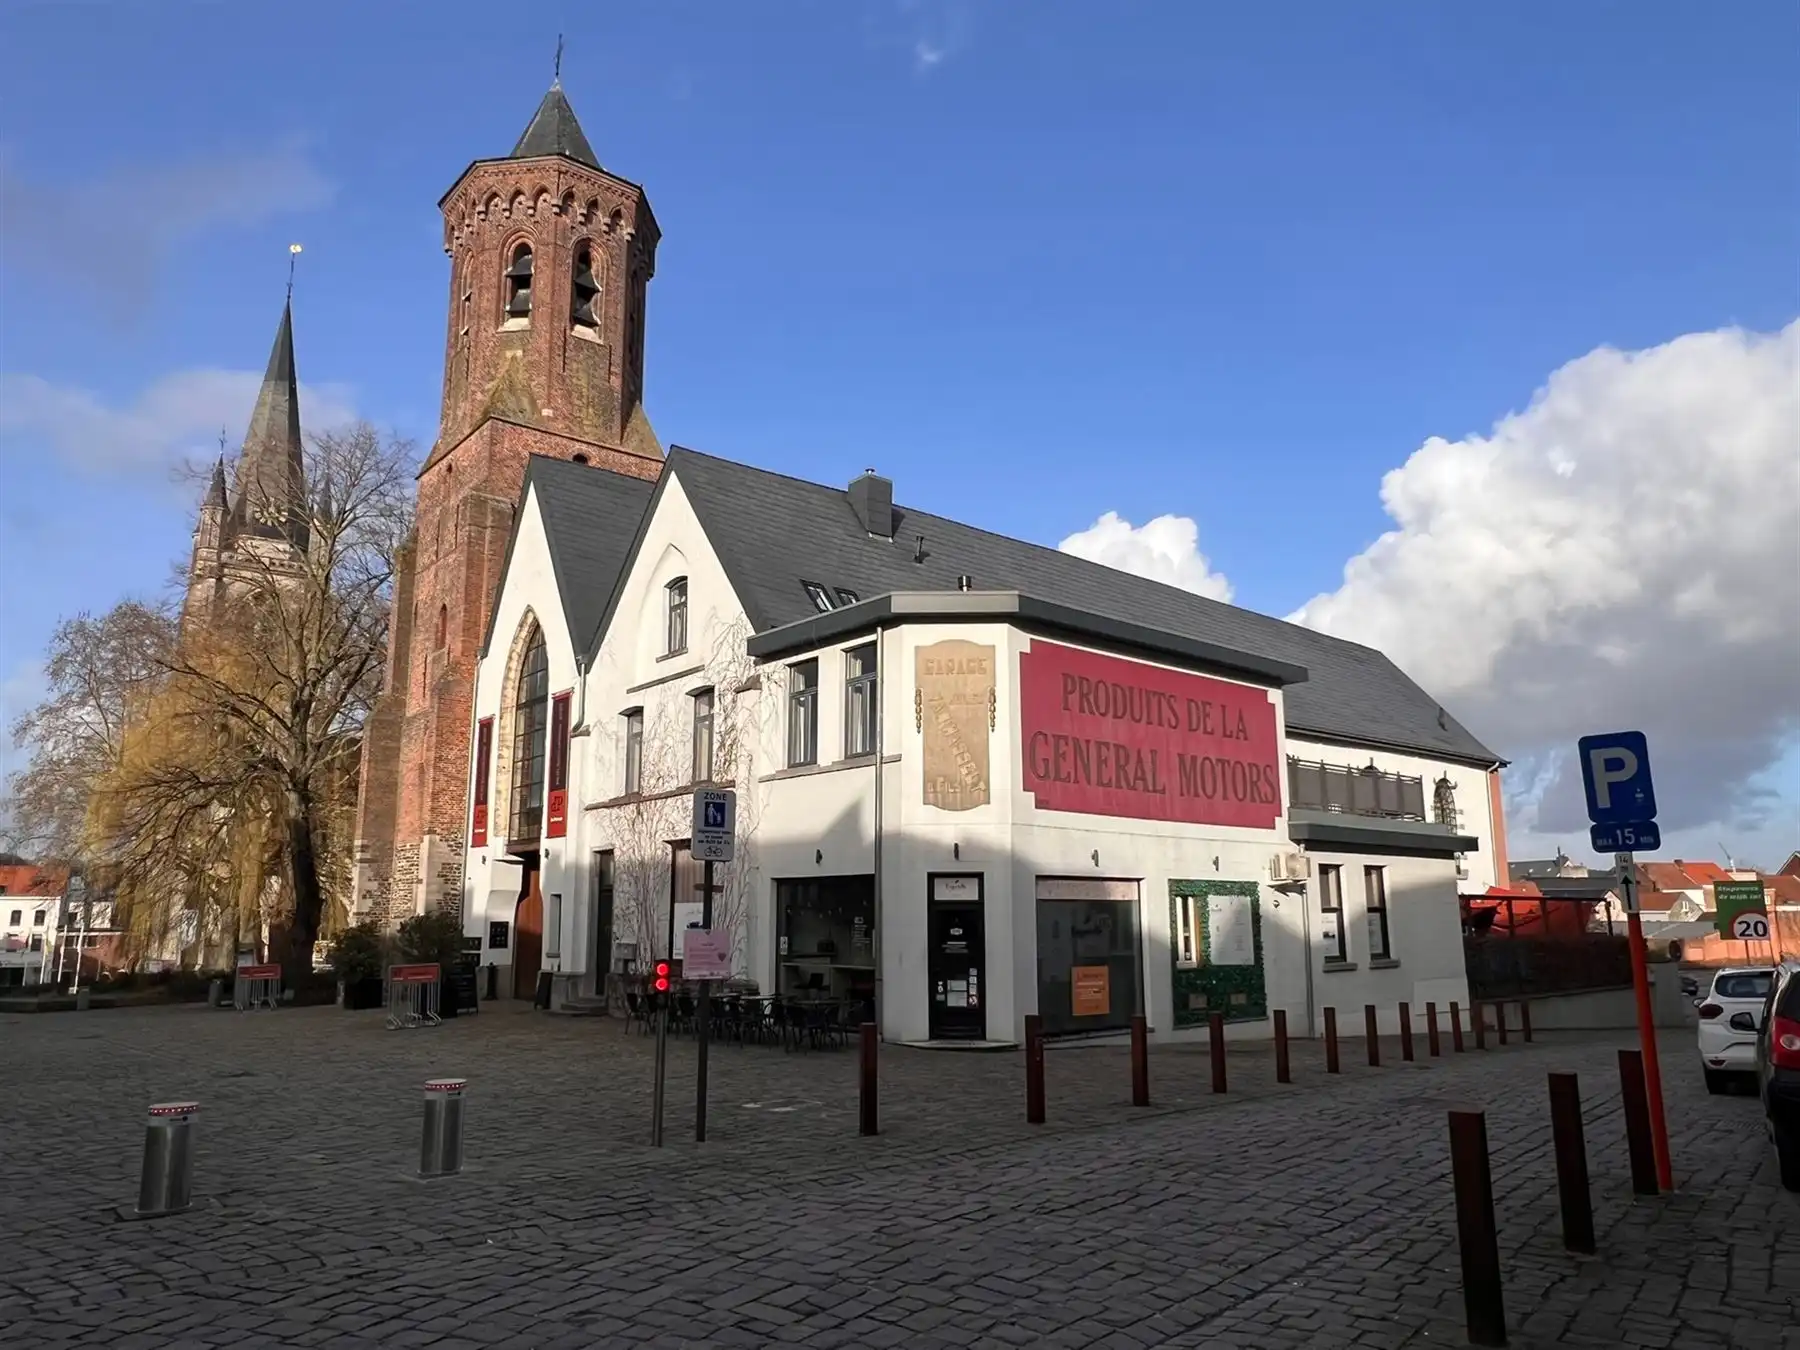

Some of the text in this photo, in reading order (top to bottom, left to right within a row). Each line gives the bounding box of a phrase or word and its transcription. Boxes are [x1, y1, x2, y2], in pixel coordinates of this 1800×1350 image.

[923, 657, 987, 675] GARAGE
[1061, 672, 1249, 741] PRODUITS DE LA
[1029, 730, 1277, 804] GENERAL MOTORS
[1589, 746, 1639, 809] P
[703, 792, 727, 801] ZONE
[1616, 828, 1636, 846] 15
[1737, 920, 1768, 938] 20
